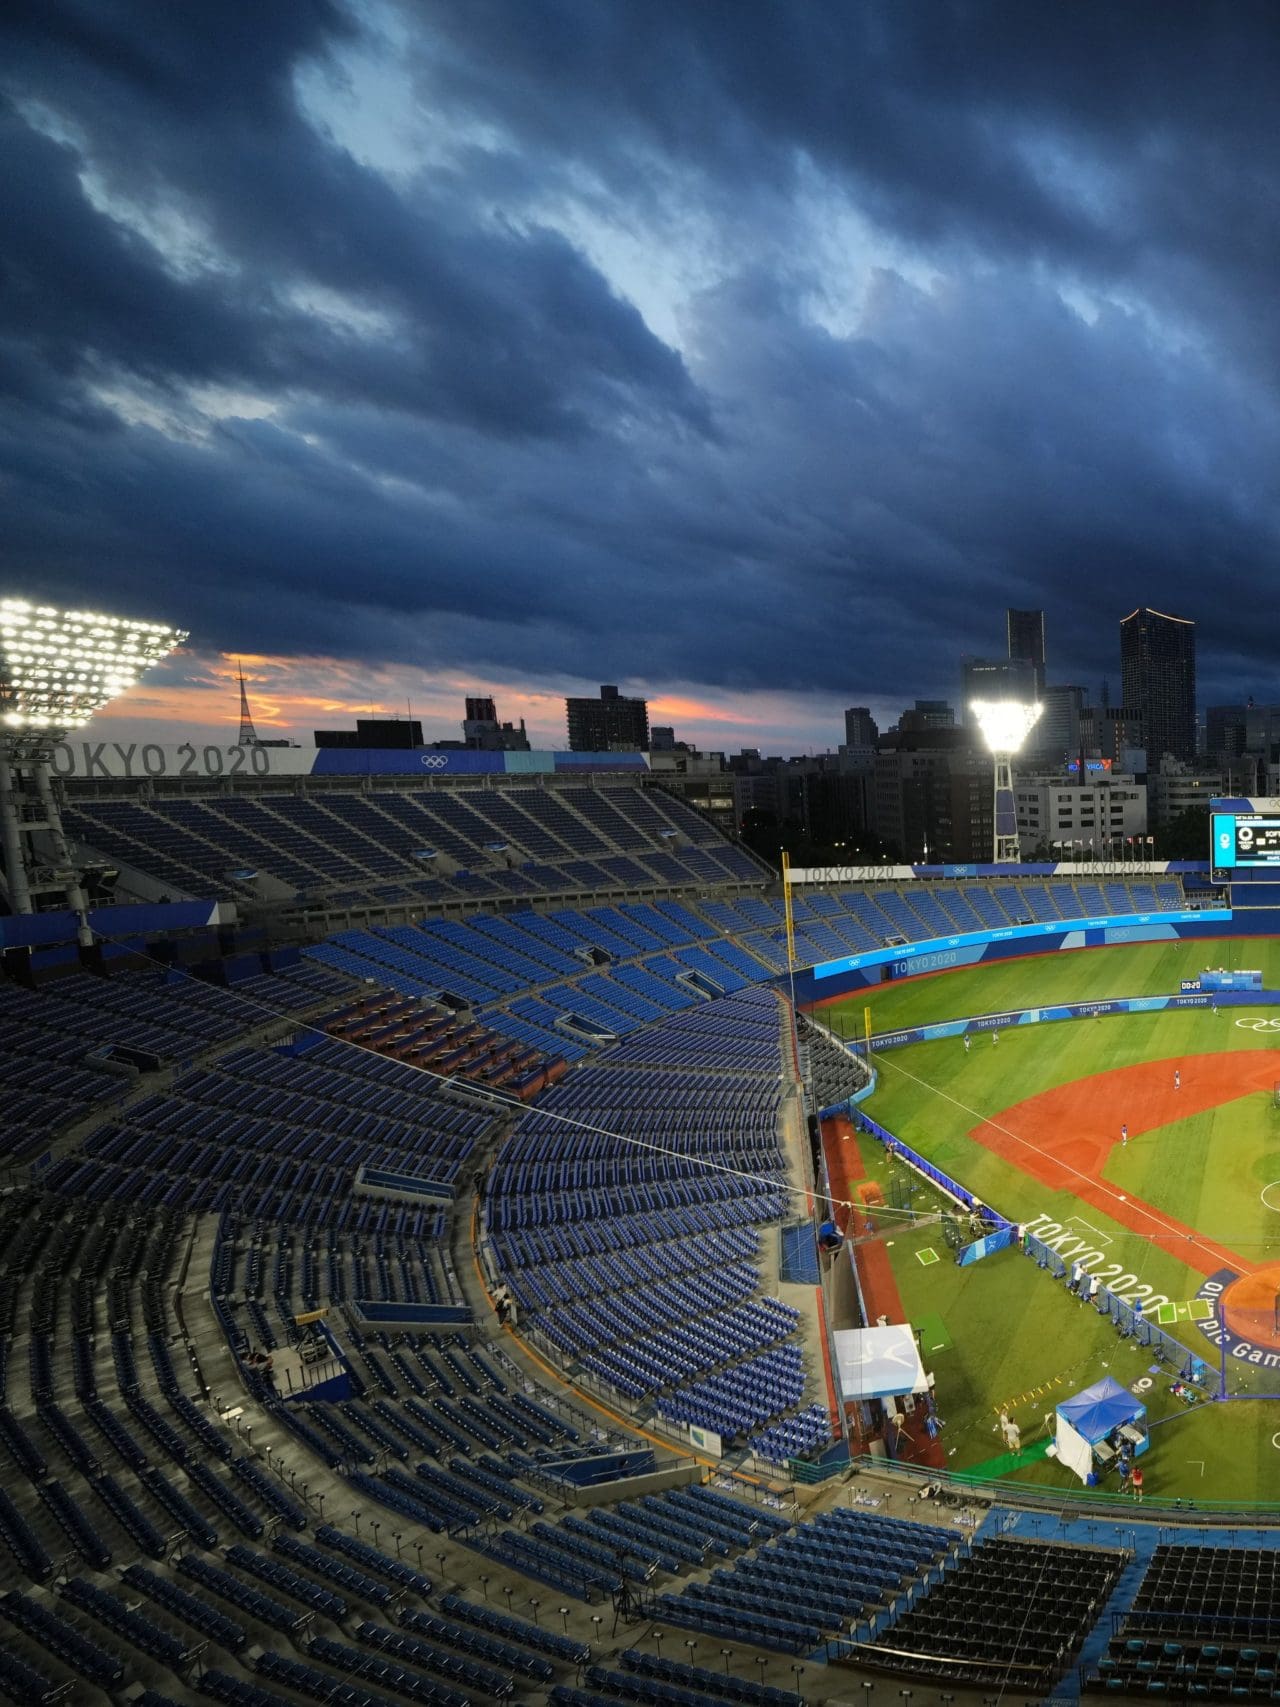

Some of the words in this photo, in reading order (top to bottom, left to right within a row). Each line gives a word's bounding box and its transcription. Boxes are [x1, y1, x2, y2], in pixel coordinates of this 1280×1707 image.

[51, 742, 166, 776] OKYO
[177, 745, 270, 776] 2020
[802, 866, 853, 882] TOKYO
[858, 866, 894, 879] 2020
[1072, 861, 1117, 874] TOKYO
[1120, 861, 1151, 873] 2020
[893, 957, 929, 975] TOKYO
[931, 952, 957, 967] 2020
[1176, 998, 1194, 1006] TOKYO
[977, 1019, 996, 1028] TOKYO
[997, 1016, 1011, 1025] 2020
[872, 1038, 892, 1048] TOKYO
[893, 1034, 908, 1044] 2020
[1025, 1213, 1105, 1269] TOKYO
[1089, 1263, 1169, 1315] 2020
